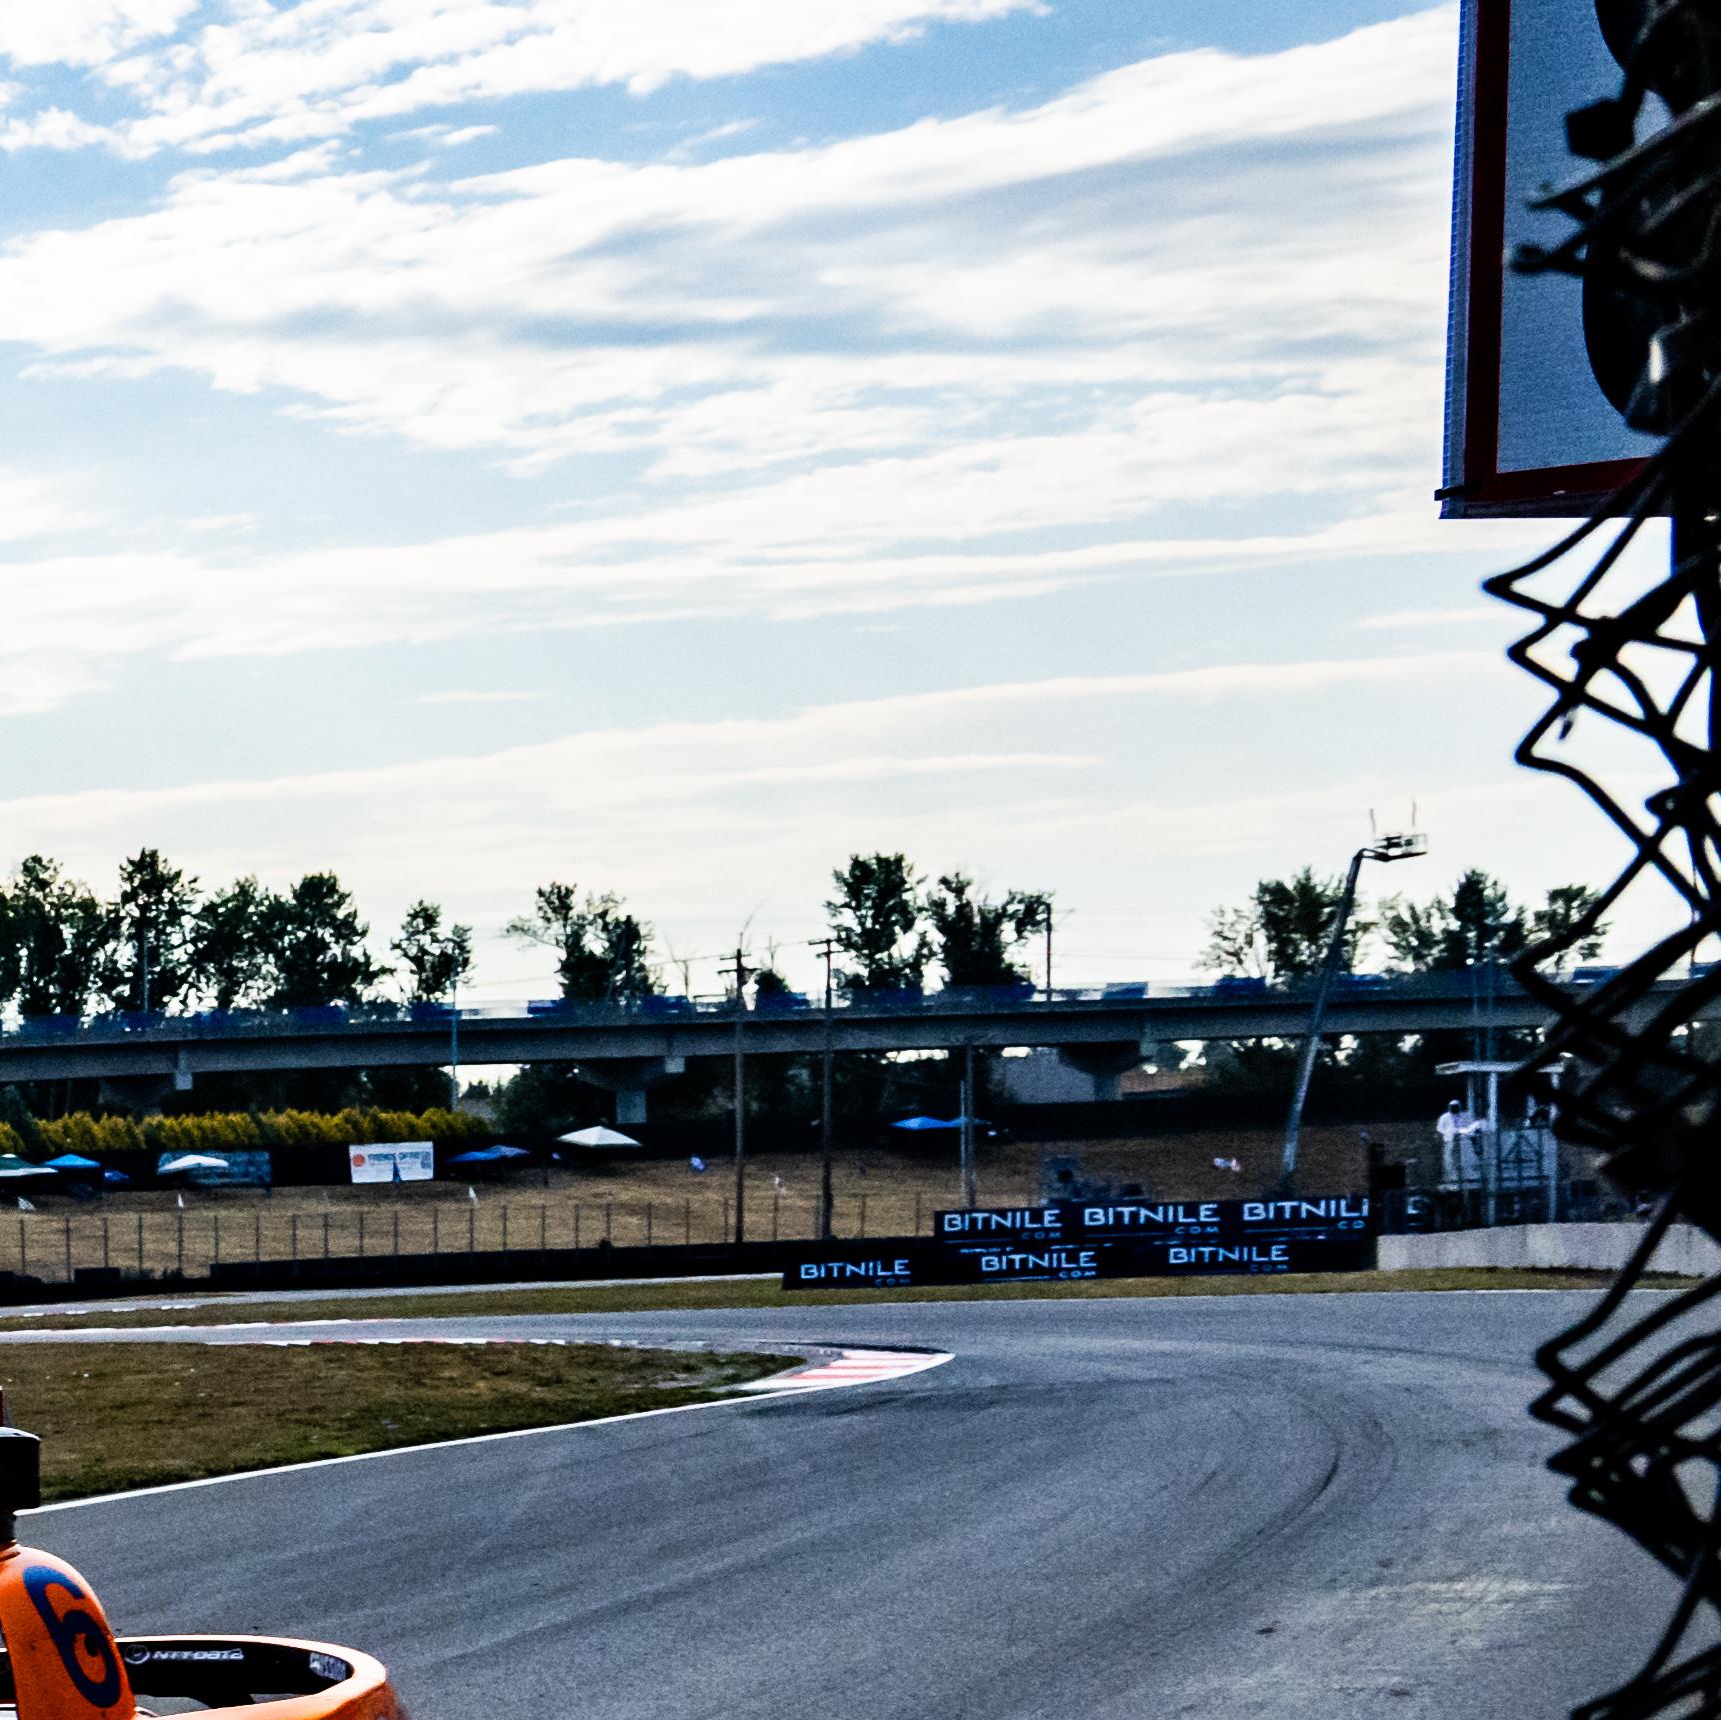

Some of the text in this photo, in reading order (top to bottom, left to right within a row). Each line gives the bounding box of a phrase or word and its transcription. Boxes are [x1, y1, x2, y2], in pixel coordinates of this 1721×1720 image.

[943, 1208, 1063, 1232] BITNILE
[1082, 1203, 1221, 1227] BITNILE
[980, 1250, 1097, 1273] BITNILE
[1168, 1243, 1289, 1265] BITNILE
[799, 1258, 912, 1280] BITNILE
[23, 1564, 120, 1708] 6
